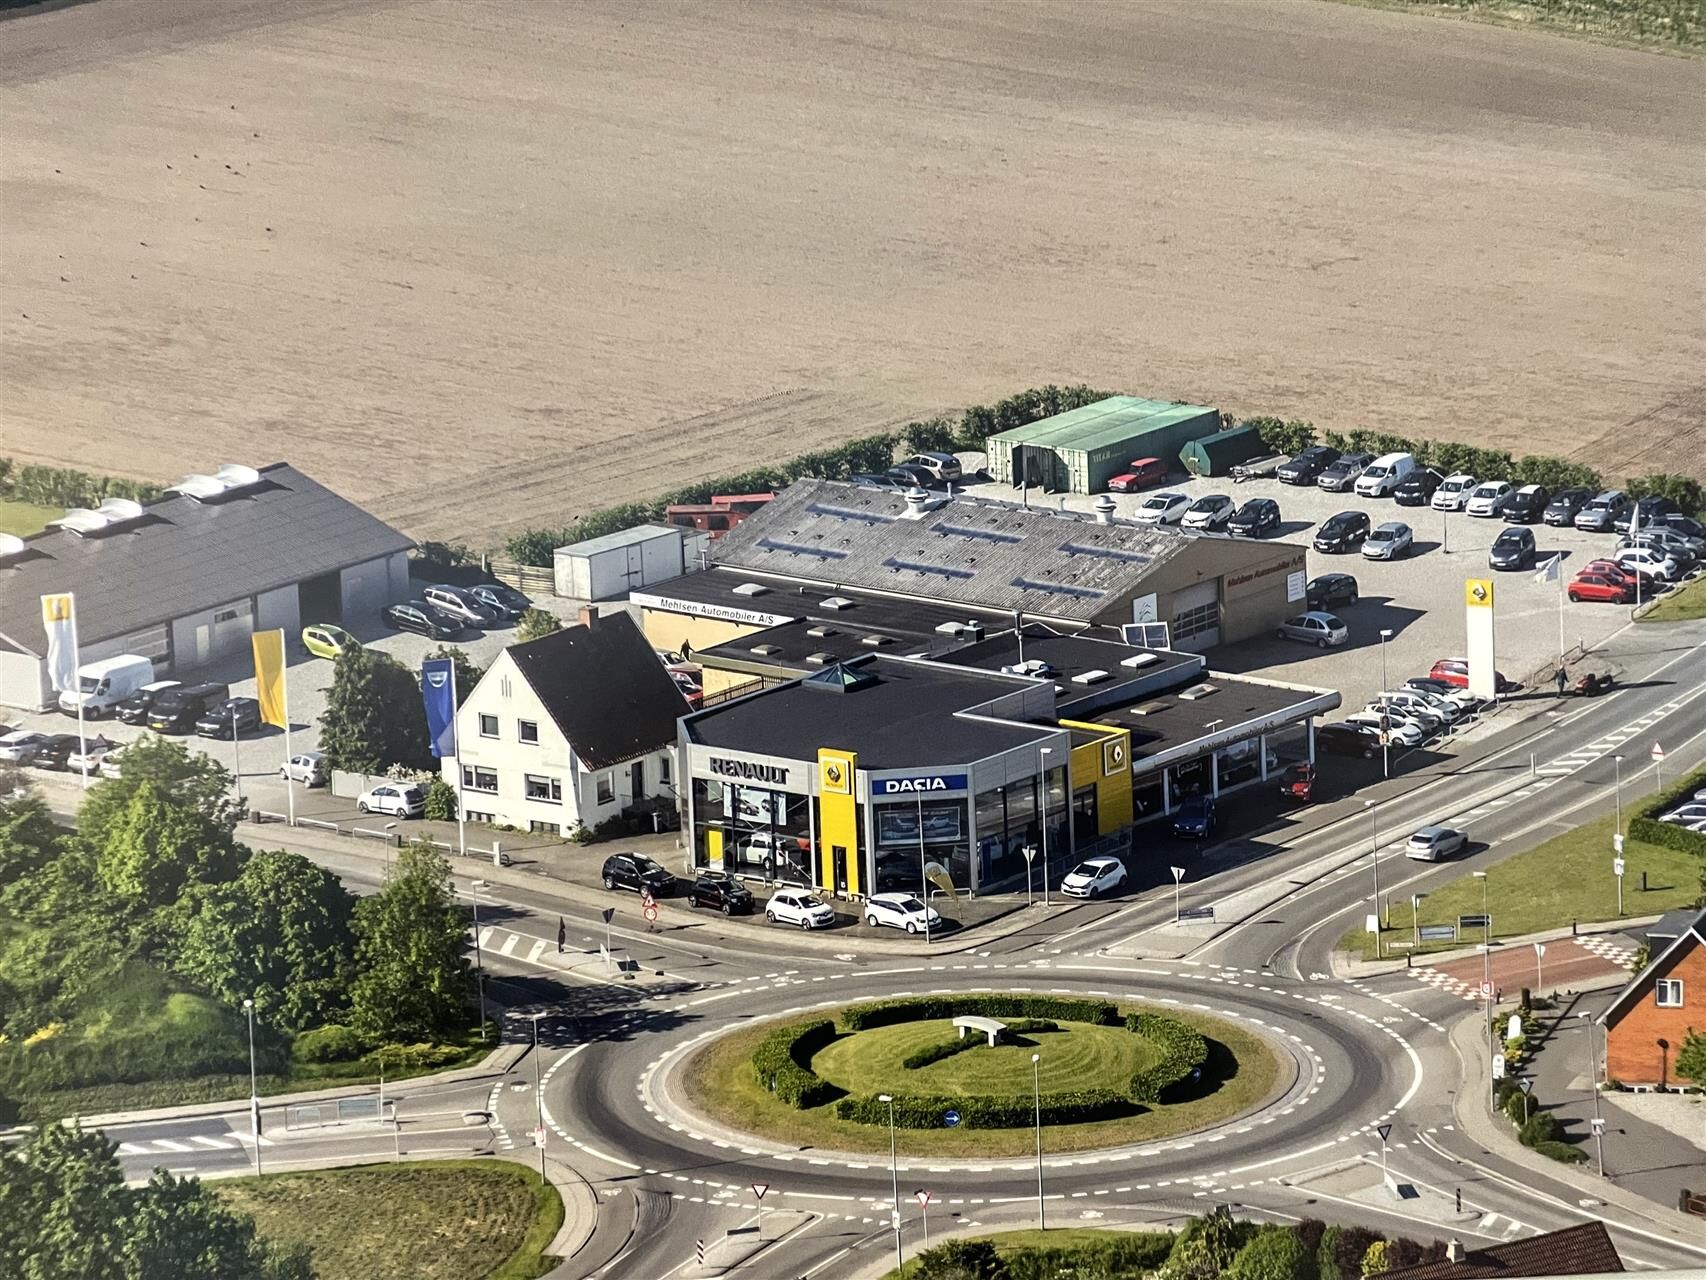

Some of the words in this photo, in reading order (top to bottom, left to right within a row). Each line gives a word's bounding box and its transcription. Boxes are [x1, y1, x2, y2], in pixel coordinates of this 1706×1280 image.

[660, 599, 698, 612] Mehlsen
[701, 605, 756, 622] Automobiler
[758, 614, 774, 625] A/S
[709, 757, 790, 785] RENAULT
[886, 777, 947, 793] DACIA
